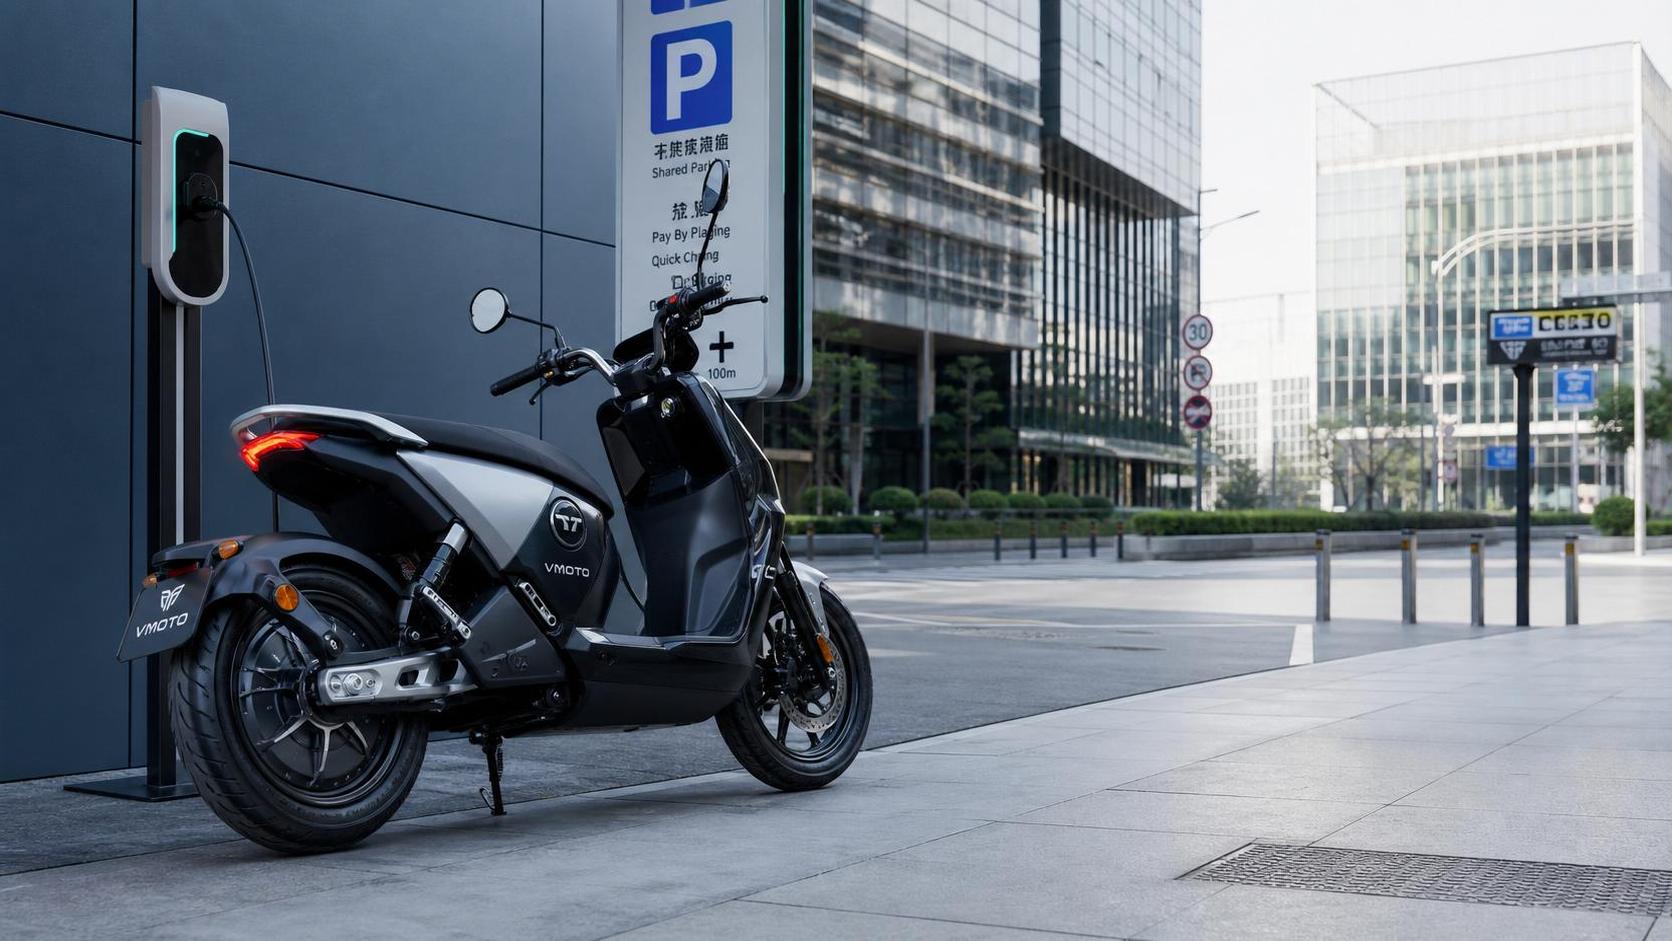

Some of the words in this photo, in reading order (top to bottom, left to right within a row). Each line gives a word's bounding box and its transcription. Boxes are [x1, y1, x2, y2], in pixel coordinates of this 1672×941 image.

[666, 38, 718, 121] P
[652, 163, 688, 179] Shared
[652, 231, 672, 245] Pay
[674, 229, 688, 243] By
[652, 252, 682, 268] Quick
[1188, 323, 1207, 341] 30
[709, 367, 736, 380] 100m
[544, 562, 590, 578] VMOTO
[136, 612, 189, 638] VMOTO
